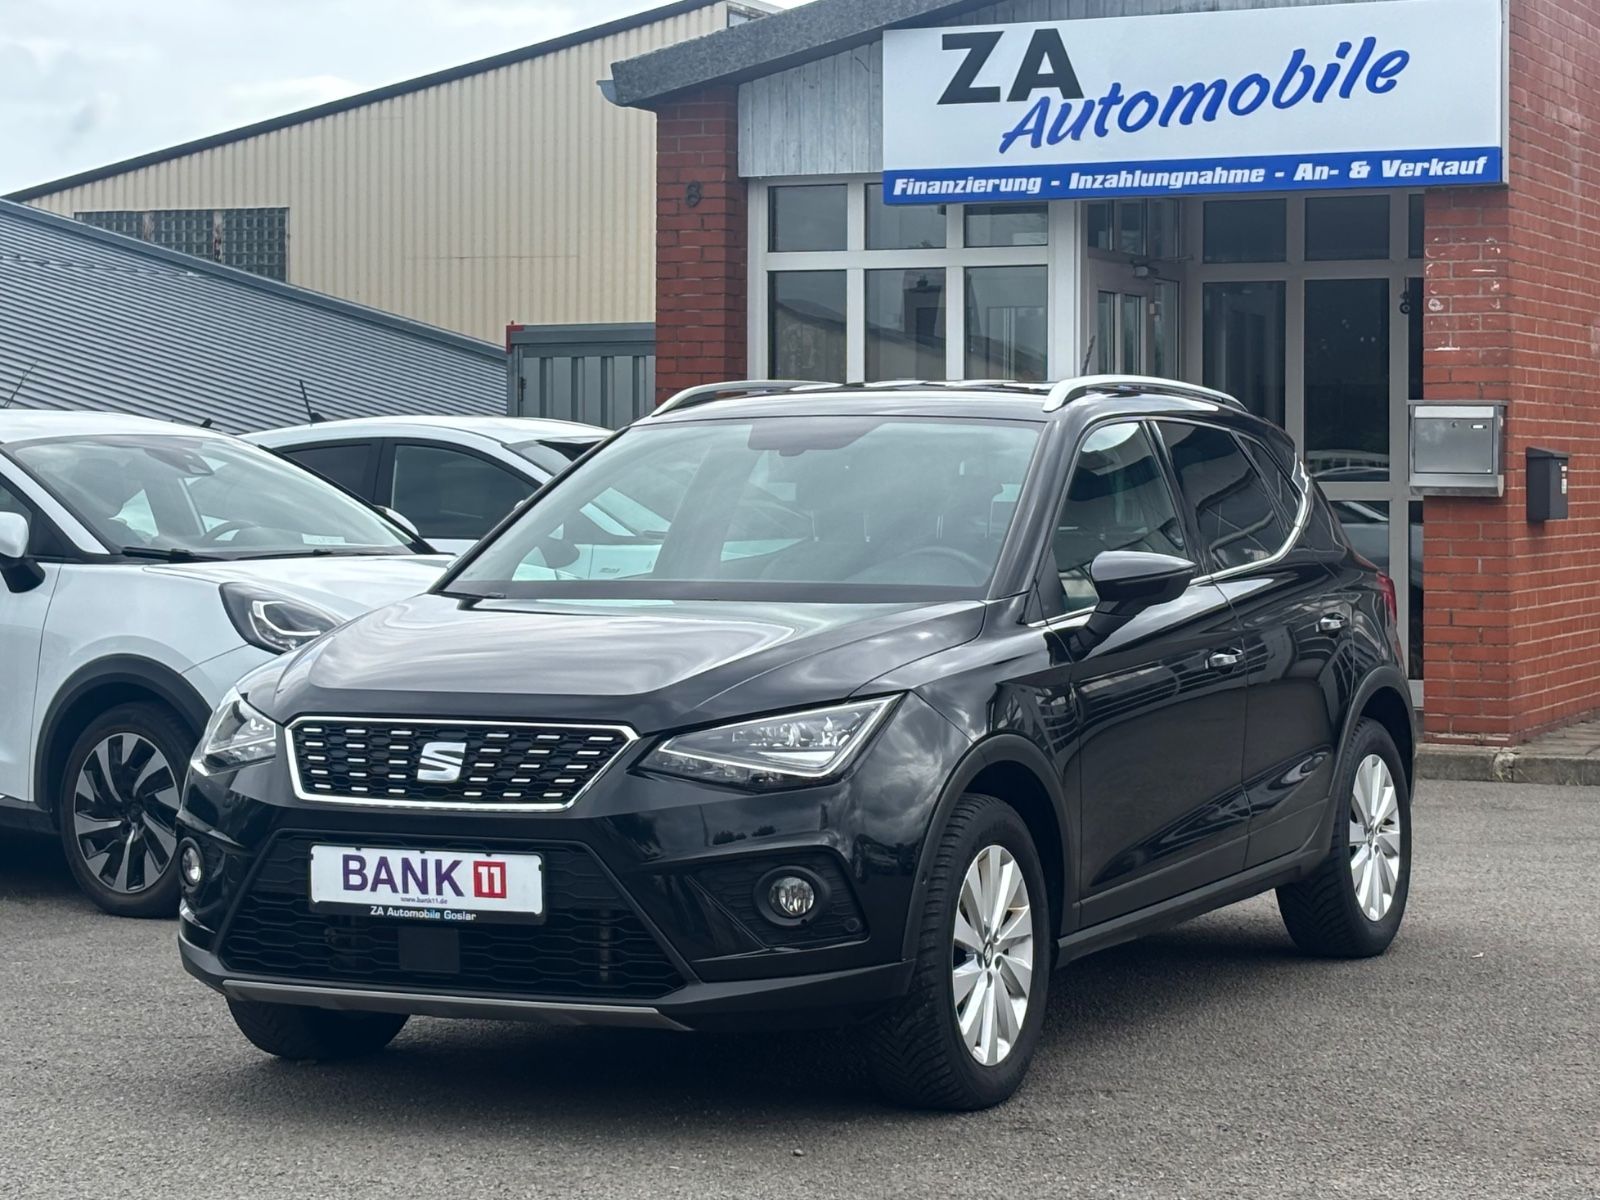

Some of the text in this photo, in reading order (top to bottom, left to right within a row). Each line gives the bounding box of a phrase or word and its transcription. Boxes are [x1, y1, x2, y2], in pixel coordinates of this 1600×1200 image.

[937, 28, 1085, 105] ZA
[998, 36, 1410, 154] Automobile
[893, 176, 1042, 195] Finanzierung
[1069, 166, 1265, 190] Inzahlungnahme
[1293, 162, 1340, 181] An-
[1349, 160, 1371, 179] &
[1382, 156, 1489, 178] Verkauf
[342, 854, 503, 897] BANK 11
[370, 905, 477, 921] ZA Automobile Goslar
